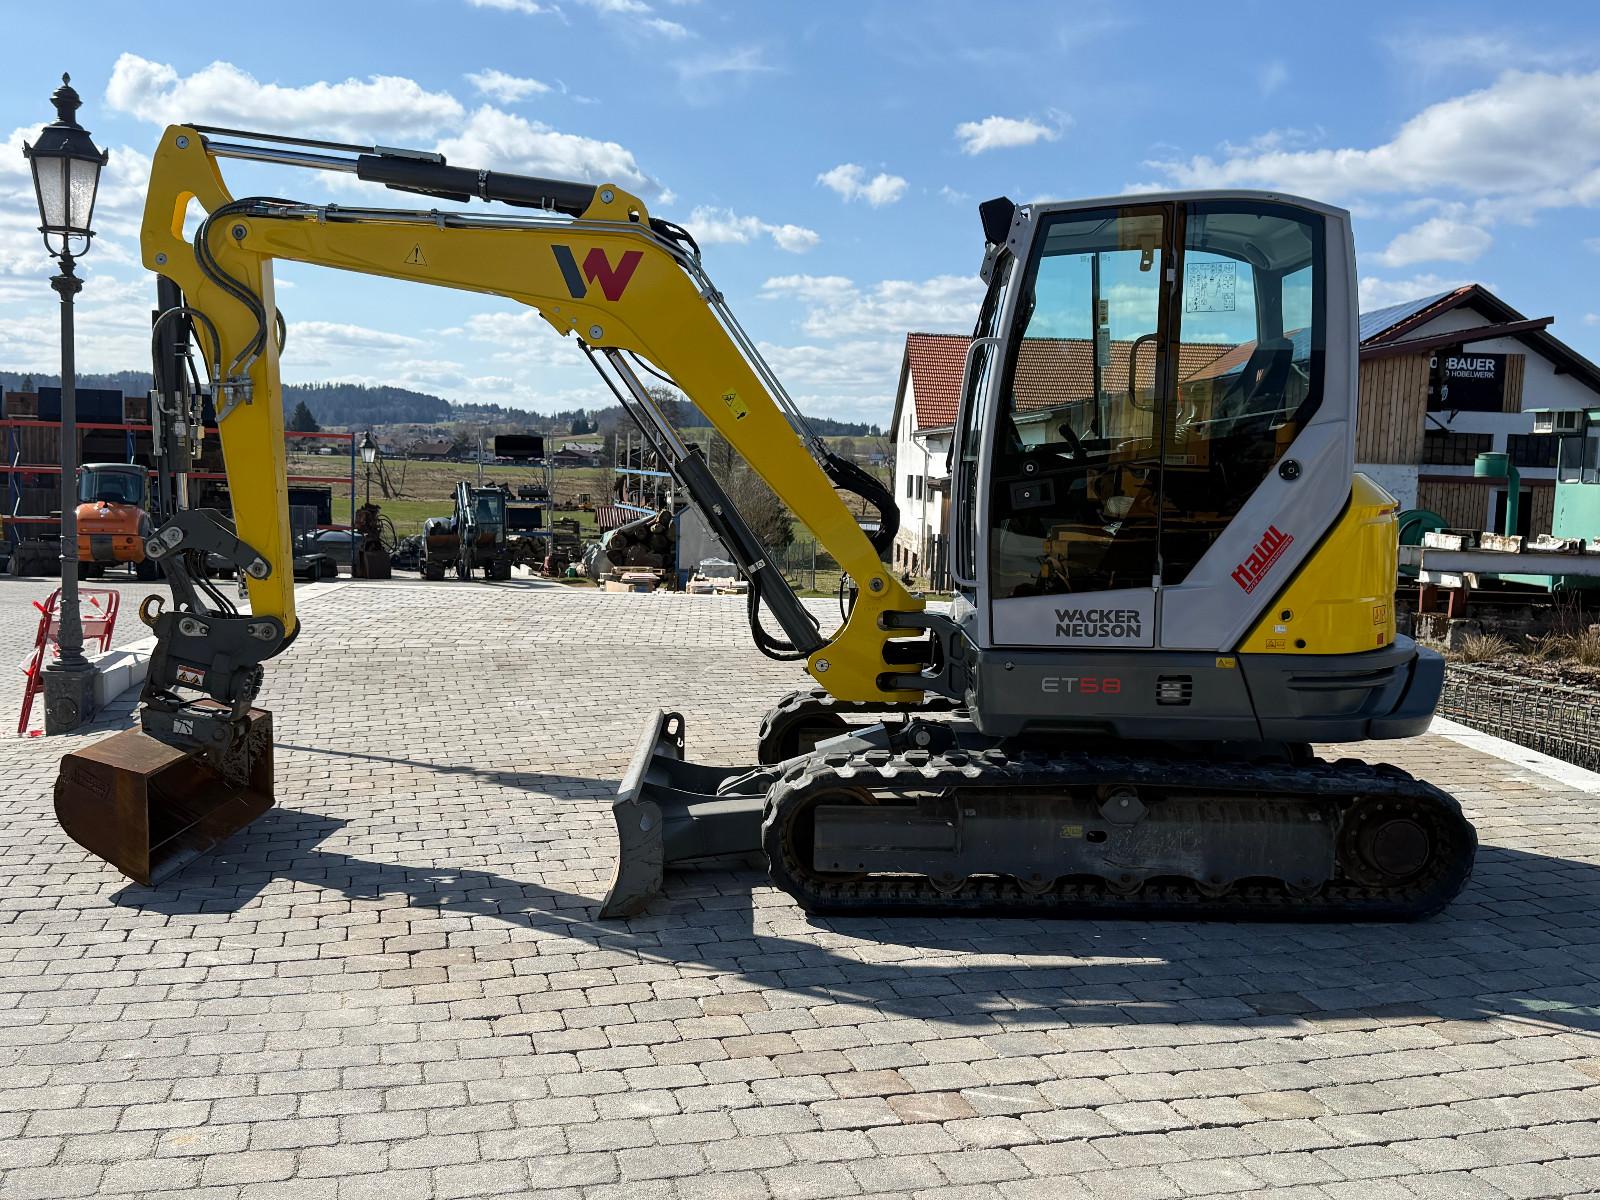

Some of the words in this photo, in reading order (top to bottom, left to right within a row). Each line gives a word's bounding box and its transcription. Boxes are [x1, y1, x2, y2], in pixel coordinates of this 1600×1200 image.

[1451, 370, 1494, 379] HOBELWERK
[1055, 609, 1141, 623] WACKER
[1055, 623, 1142, 638] NEUSON
[1041, 677, 1121, 694] ET58
